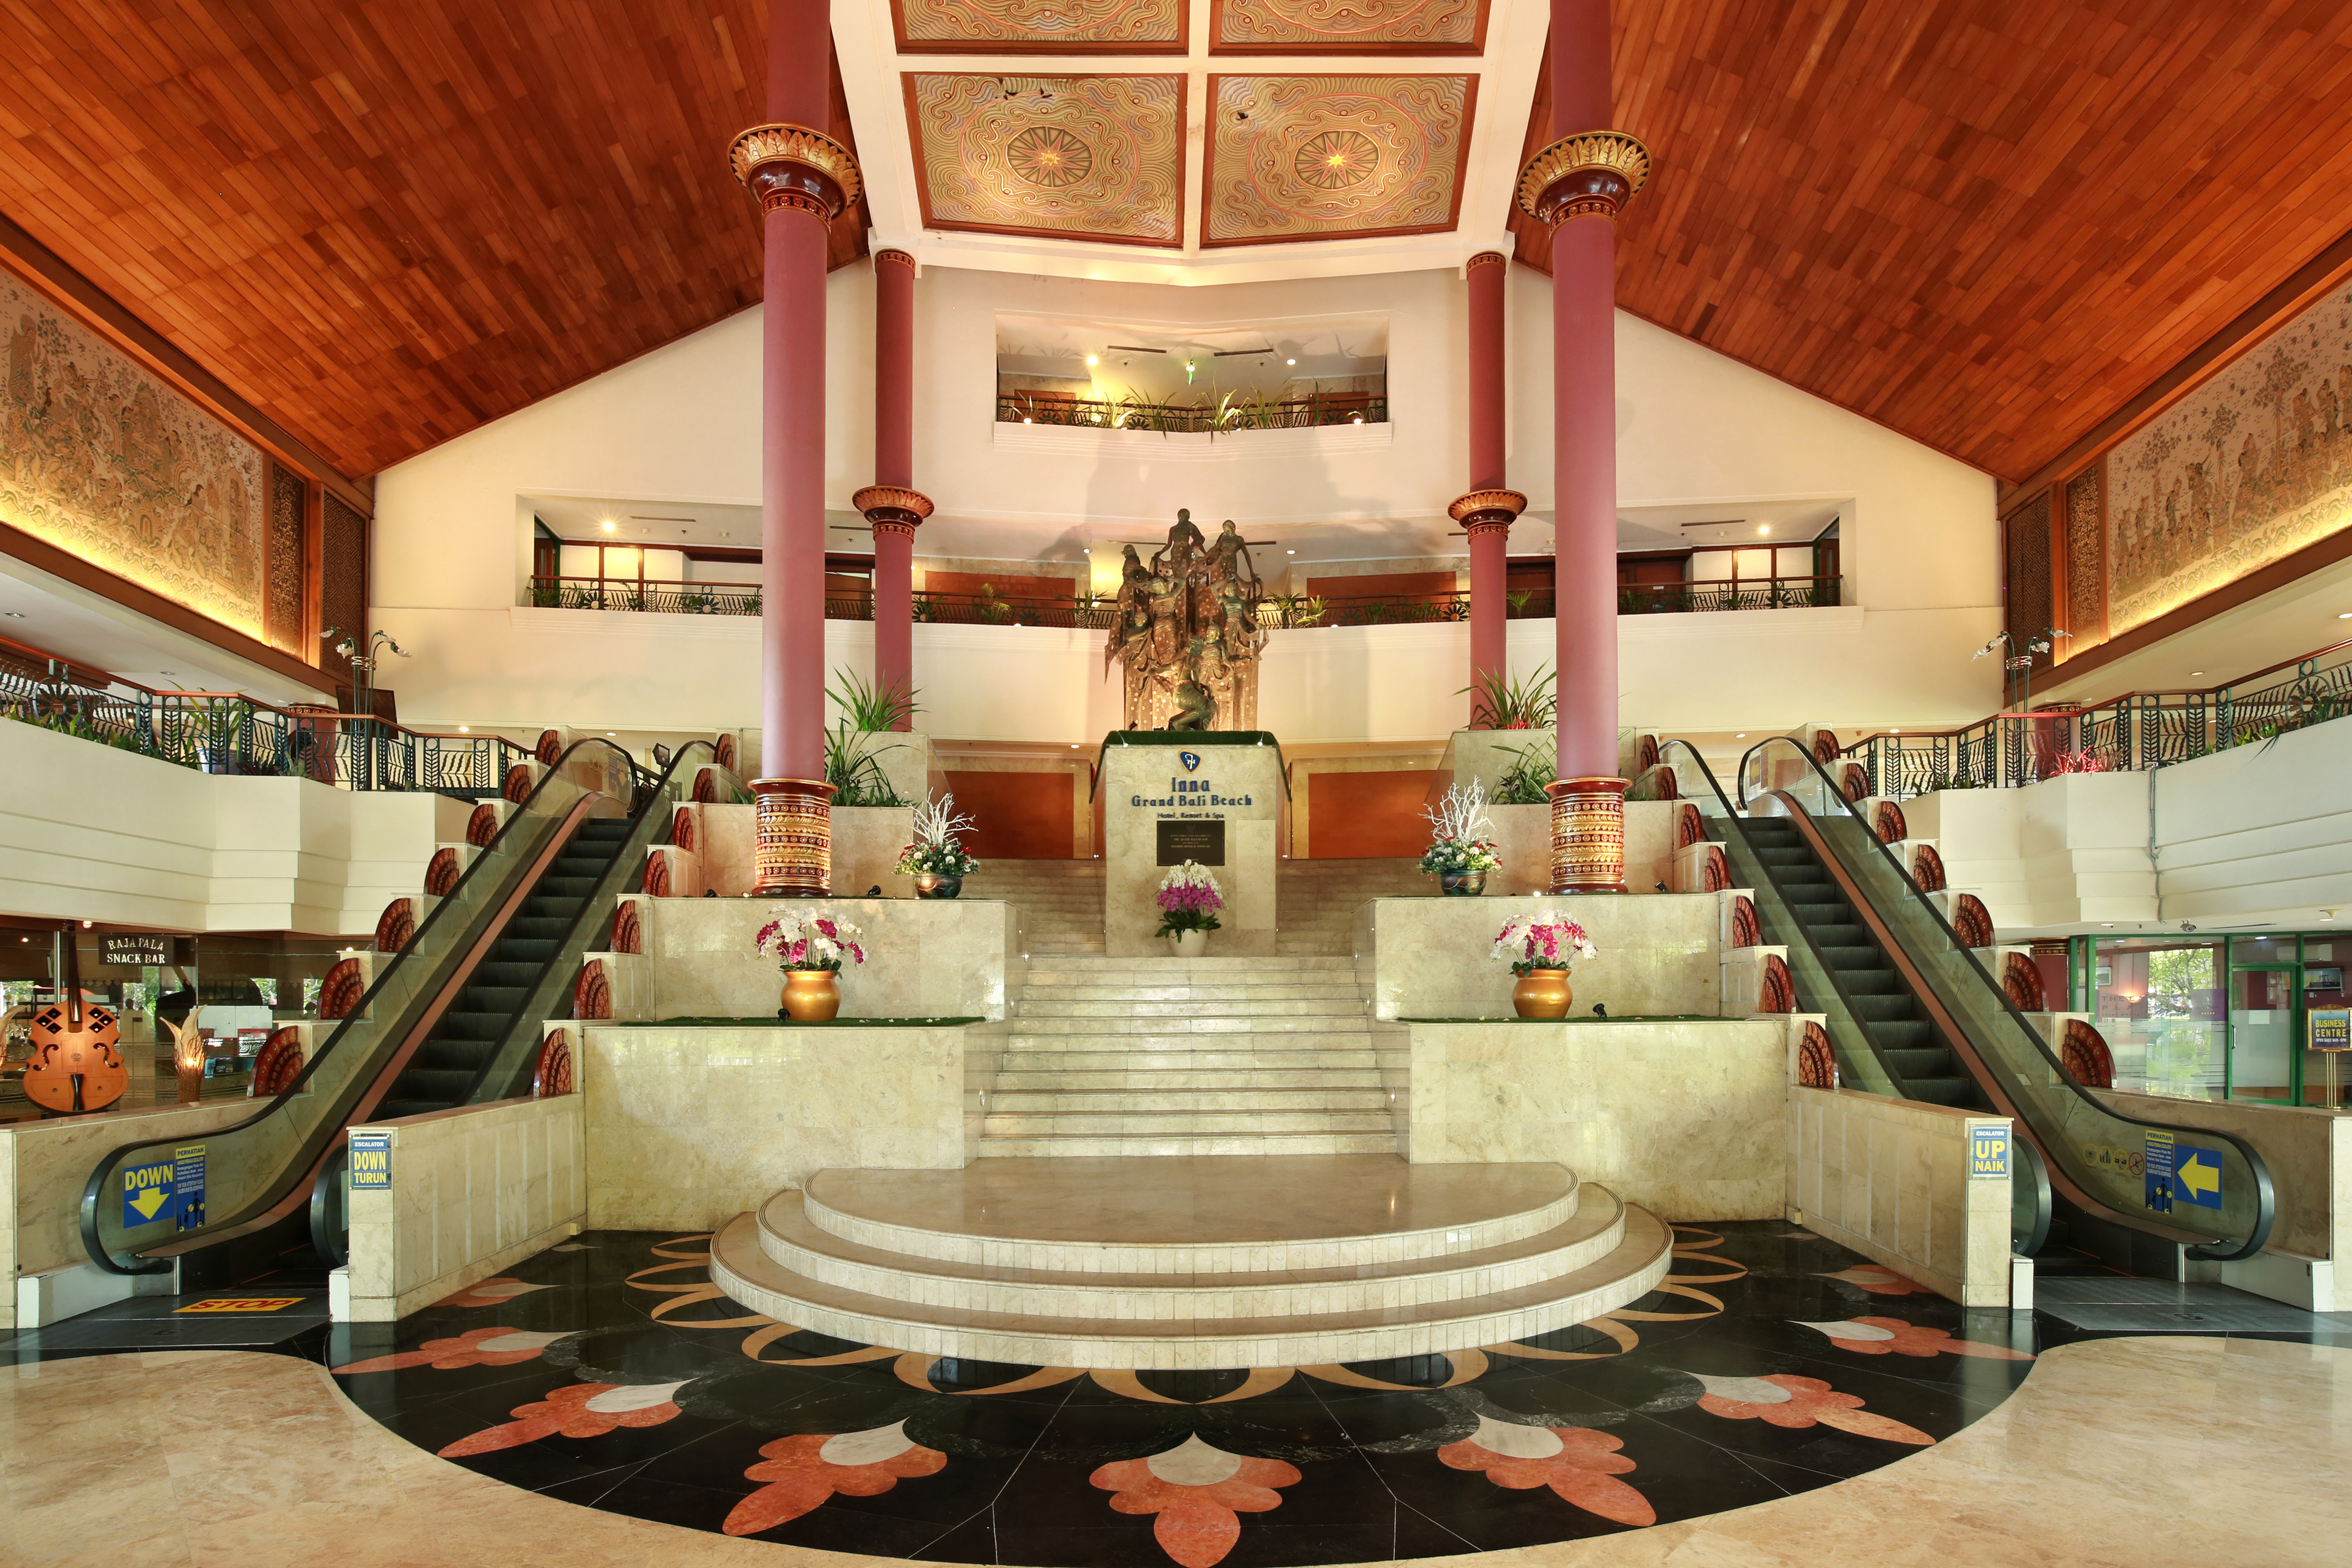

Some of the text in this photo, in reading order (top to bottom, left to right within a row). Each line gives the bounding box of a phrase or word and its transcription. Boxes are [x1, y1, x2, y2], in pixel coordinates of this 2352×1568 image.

[1172, 777, 1210, 792] Inna
[1132, 794, 1252, 807] Grand Bali Beach
[107, 938, 164, 951] RAJA PALA
[107, 953, 165, 964] SNACK BAR
[2315, 1019, 2346, 1028] BUSINESS
[2316, 1029, 2346, 1037] CENTRE
[2147, 1132, 2172, 1141] PERHATIAN
[177, 1147, 204, 1156] PERHATIAN
[1976, 1140, 2005, 1159] UP
[354, 1152, 386, 1170] DOWN
[1975, 1160, 2005, 1172] NAIK
[125, 1164, 173, 1191] DOWN
[354, 1172, 386, 1183] TURUN
[190, 1300, 293, 1310] STOP
